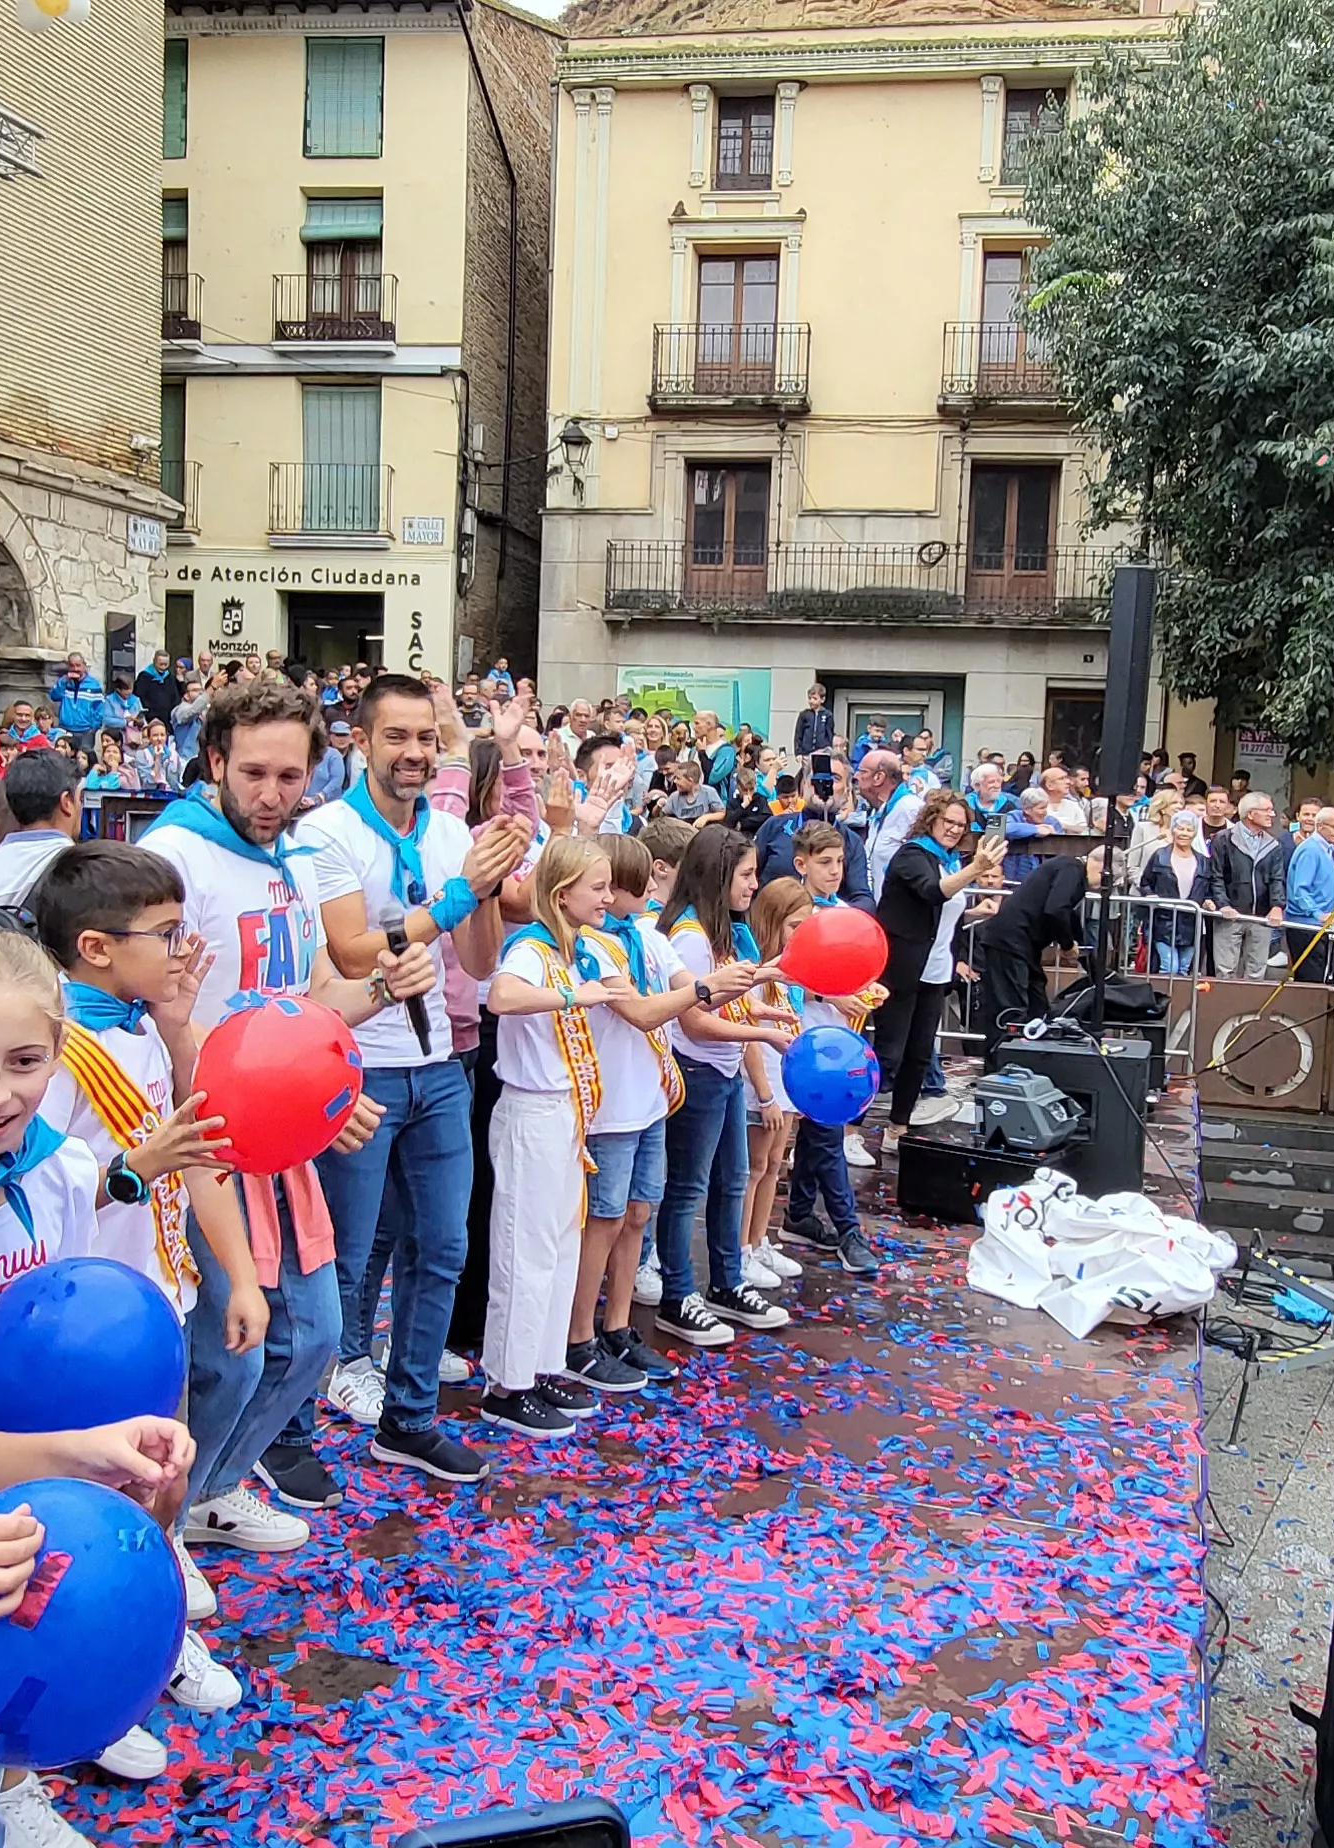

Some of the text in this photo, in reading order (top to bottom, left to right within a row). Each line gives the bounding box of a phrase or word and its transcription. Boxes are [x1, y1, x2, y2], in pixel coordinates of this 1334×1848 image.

[418, 521, 440, 530] CALLE
[408, 530, 439, 541] MAYOR
[177, 565, 202, 581] de
[211, 566, 302, 583] Atención
[311, 568, 421, 586] Ciudadana
[209, 639, 258, 652] Monzón
[408, 611, 424, 672] SAC
